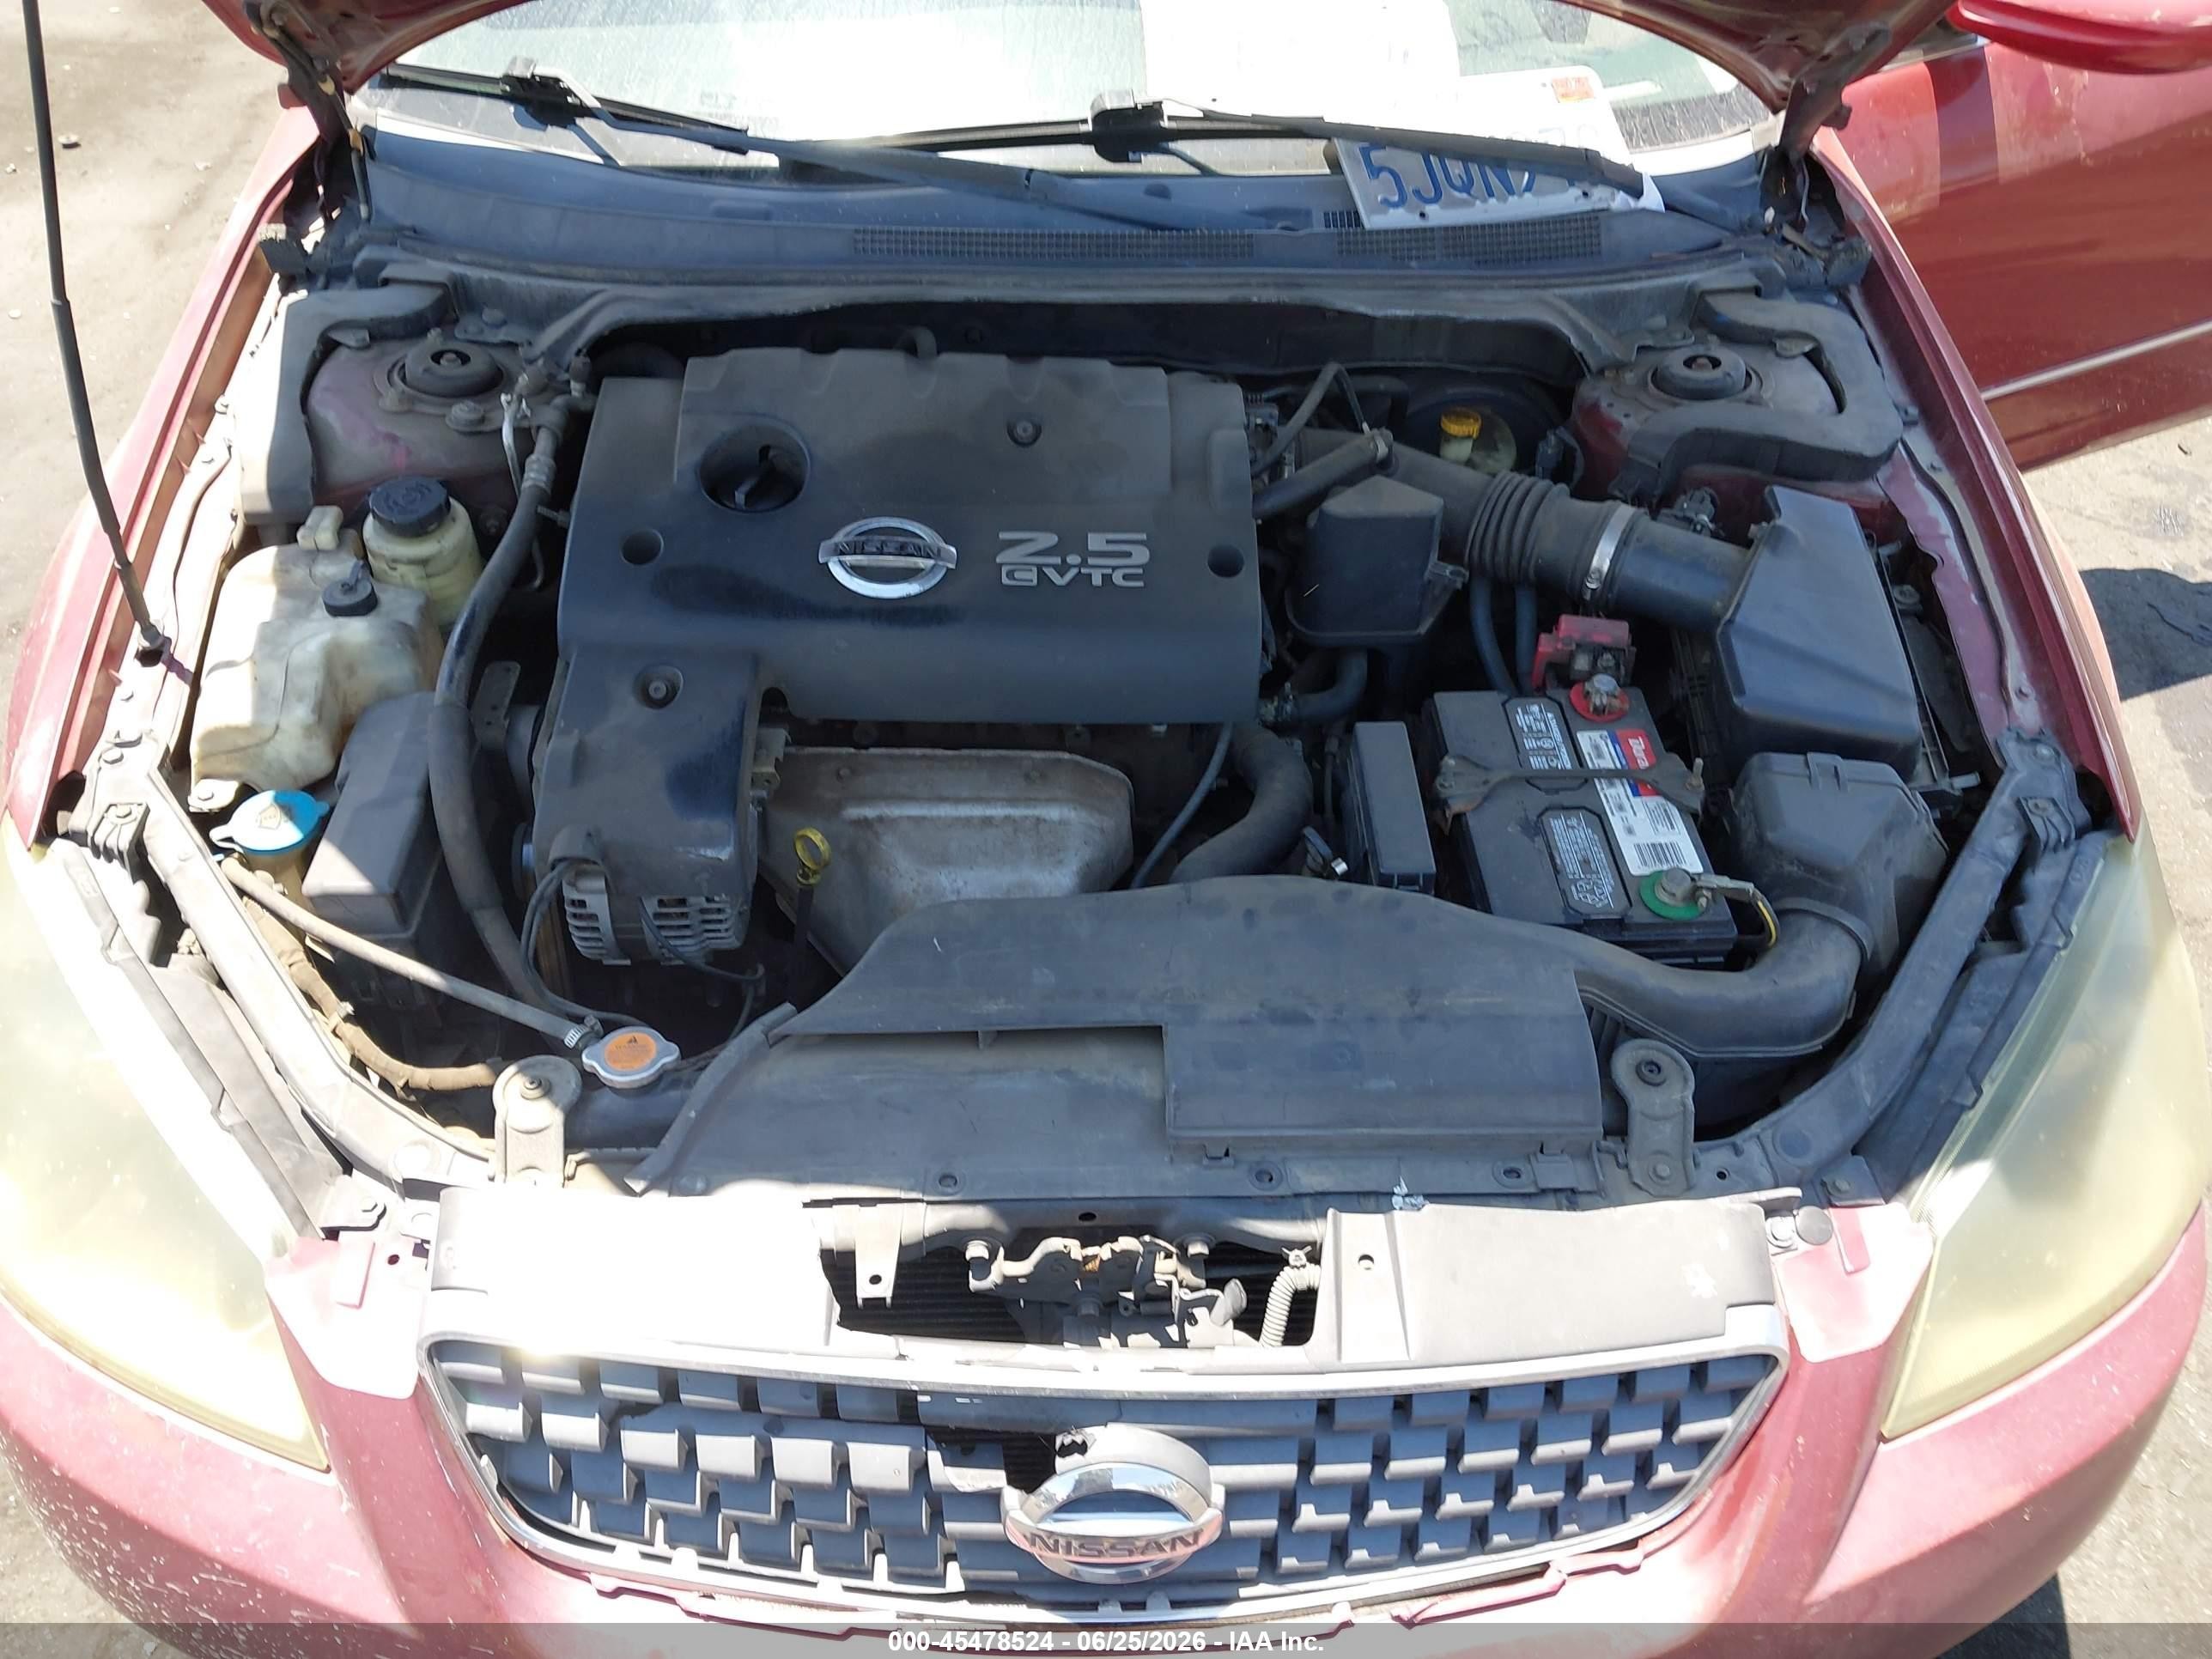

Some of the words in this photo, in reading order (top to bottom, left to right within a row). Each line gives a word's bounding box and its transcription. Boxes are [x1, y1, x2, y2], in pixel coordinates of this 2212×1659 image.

[836, 540, 942, 557] NISSAN
[996, 531, 1151, 566] 2.5
[1029, 1528, 1204, 1558] NISSAN
